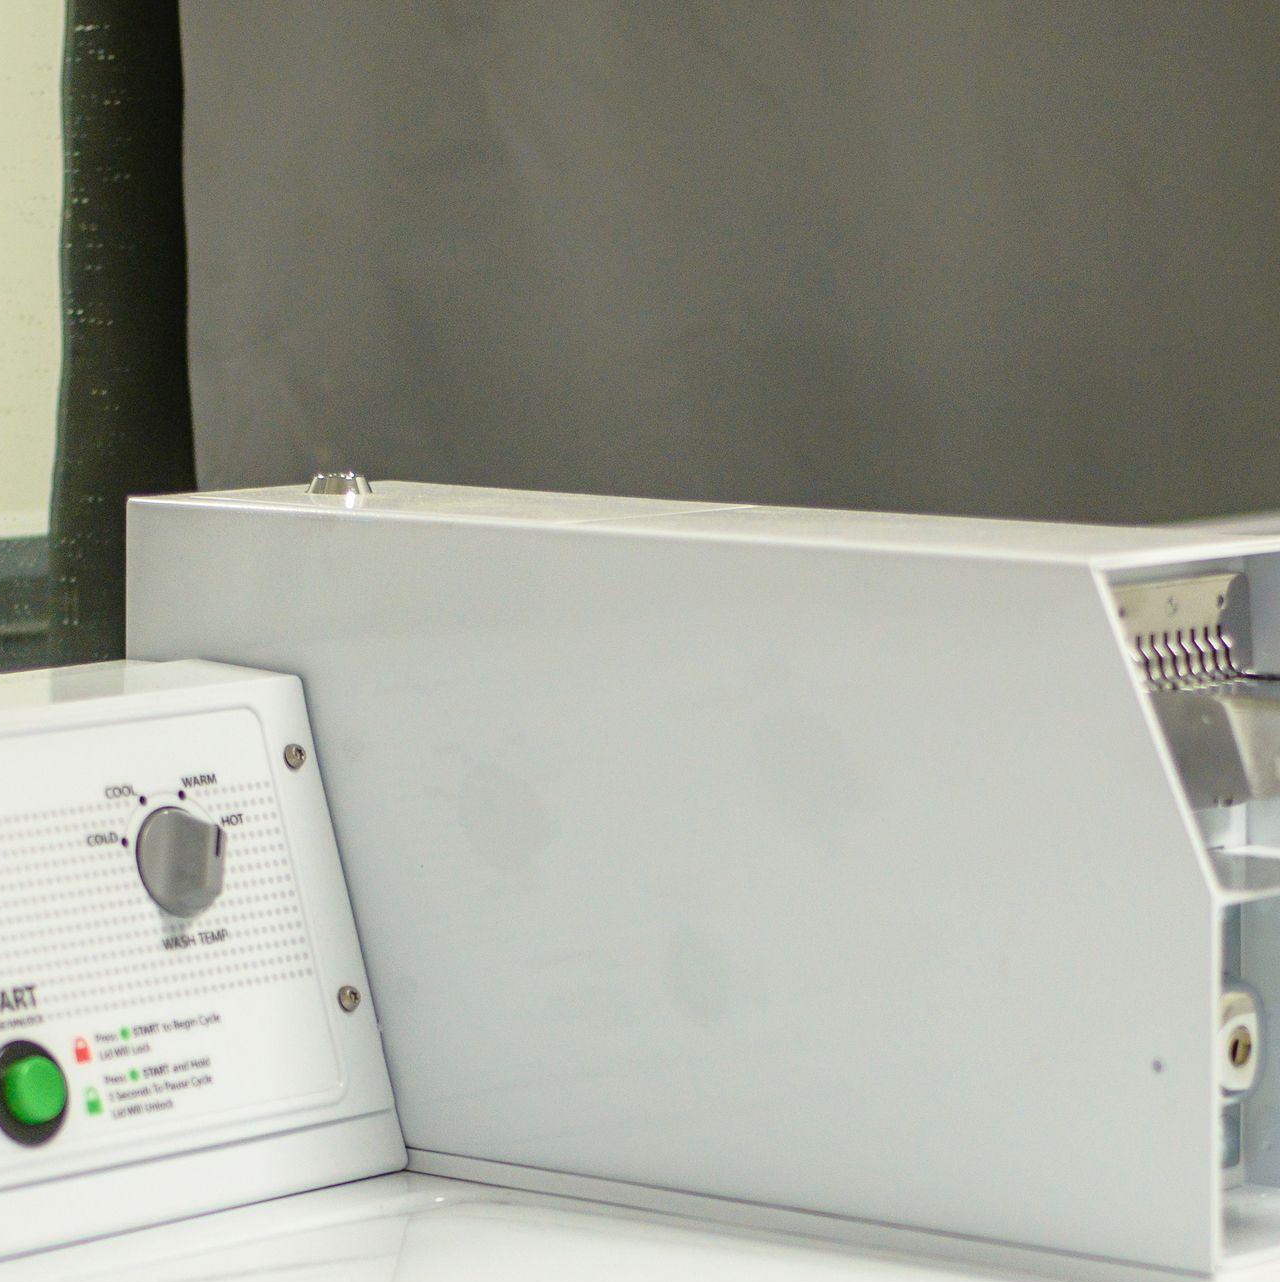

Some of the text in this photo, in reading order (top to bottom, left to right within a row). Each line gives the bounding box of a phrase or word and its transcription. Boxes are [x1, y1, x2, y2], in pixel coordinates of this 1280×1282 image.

[181, 774, 217, 788] WARM
[105, 785, 138, 799] COOL
[221, 813, 244, 826] HOT
[86, 832, 118, 846] COLD
[163, 929, 228, 950] WASH TEMP
[132, 1023, 160, 1038] START
[142, 1063, 169, 1079] START
